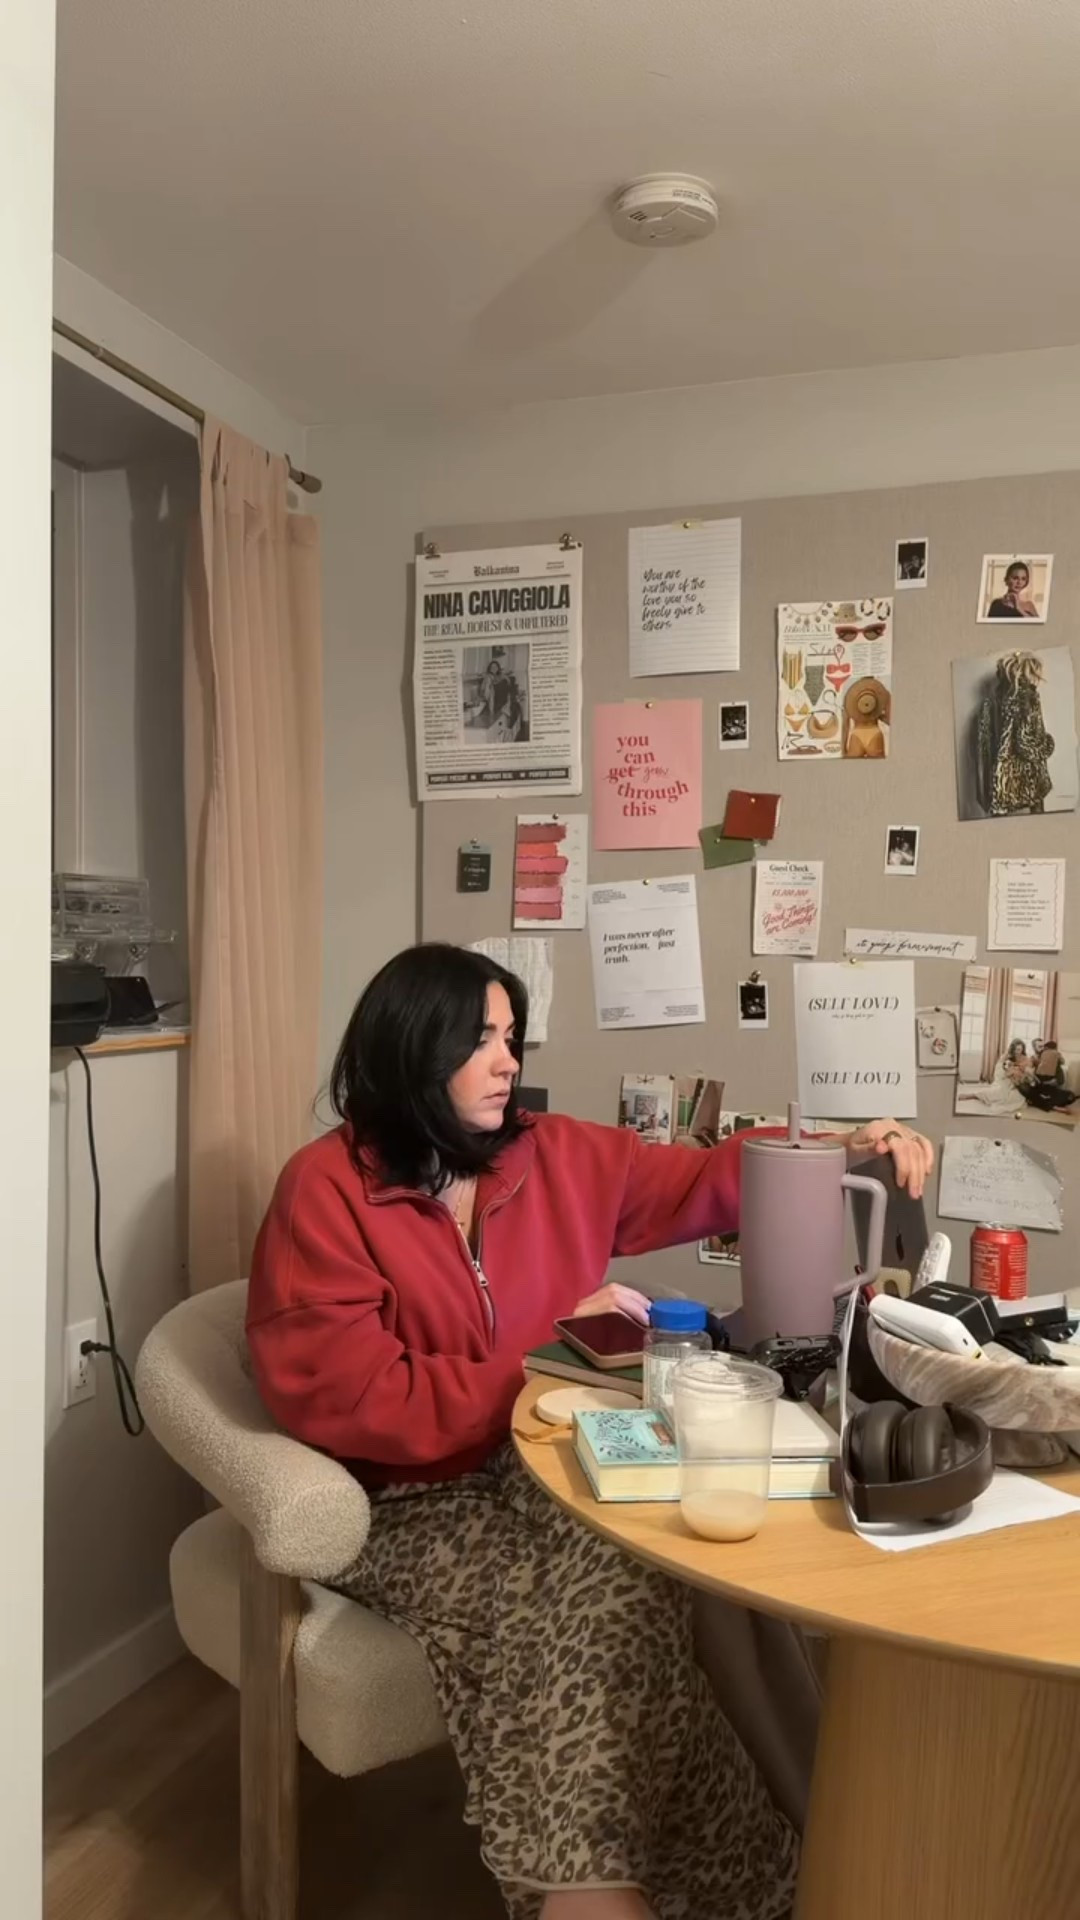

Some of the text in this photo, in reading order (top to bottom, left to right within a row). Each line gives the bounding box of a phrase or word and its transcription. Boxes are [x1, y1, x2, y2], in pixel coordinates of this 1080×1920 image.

[664, 569, 681, 580] are
[691, 577, 706, 590] the
[424, 584, 570, 619] NINA CAVIGGIOLA
[504, 619, 512, 631] &
[616, 735, 649, 753] you
[624, 751, 655, 764] can
[617, 780, 689, 803] through
[622, 801, 657, 817] this
[789, 863, 809, 872] Check
[627, 931, 651, 939] never
[652, 928, 675, 938] after
[658, 940, 676, 950] just
